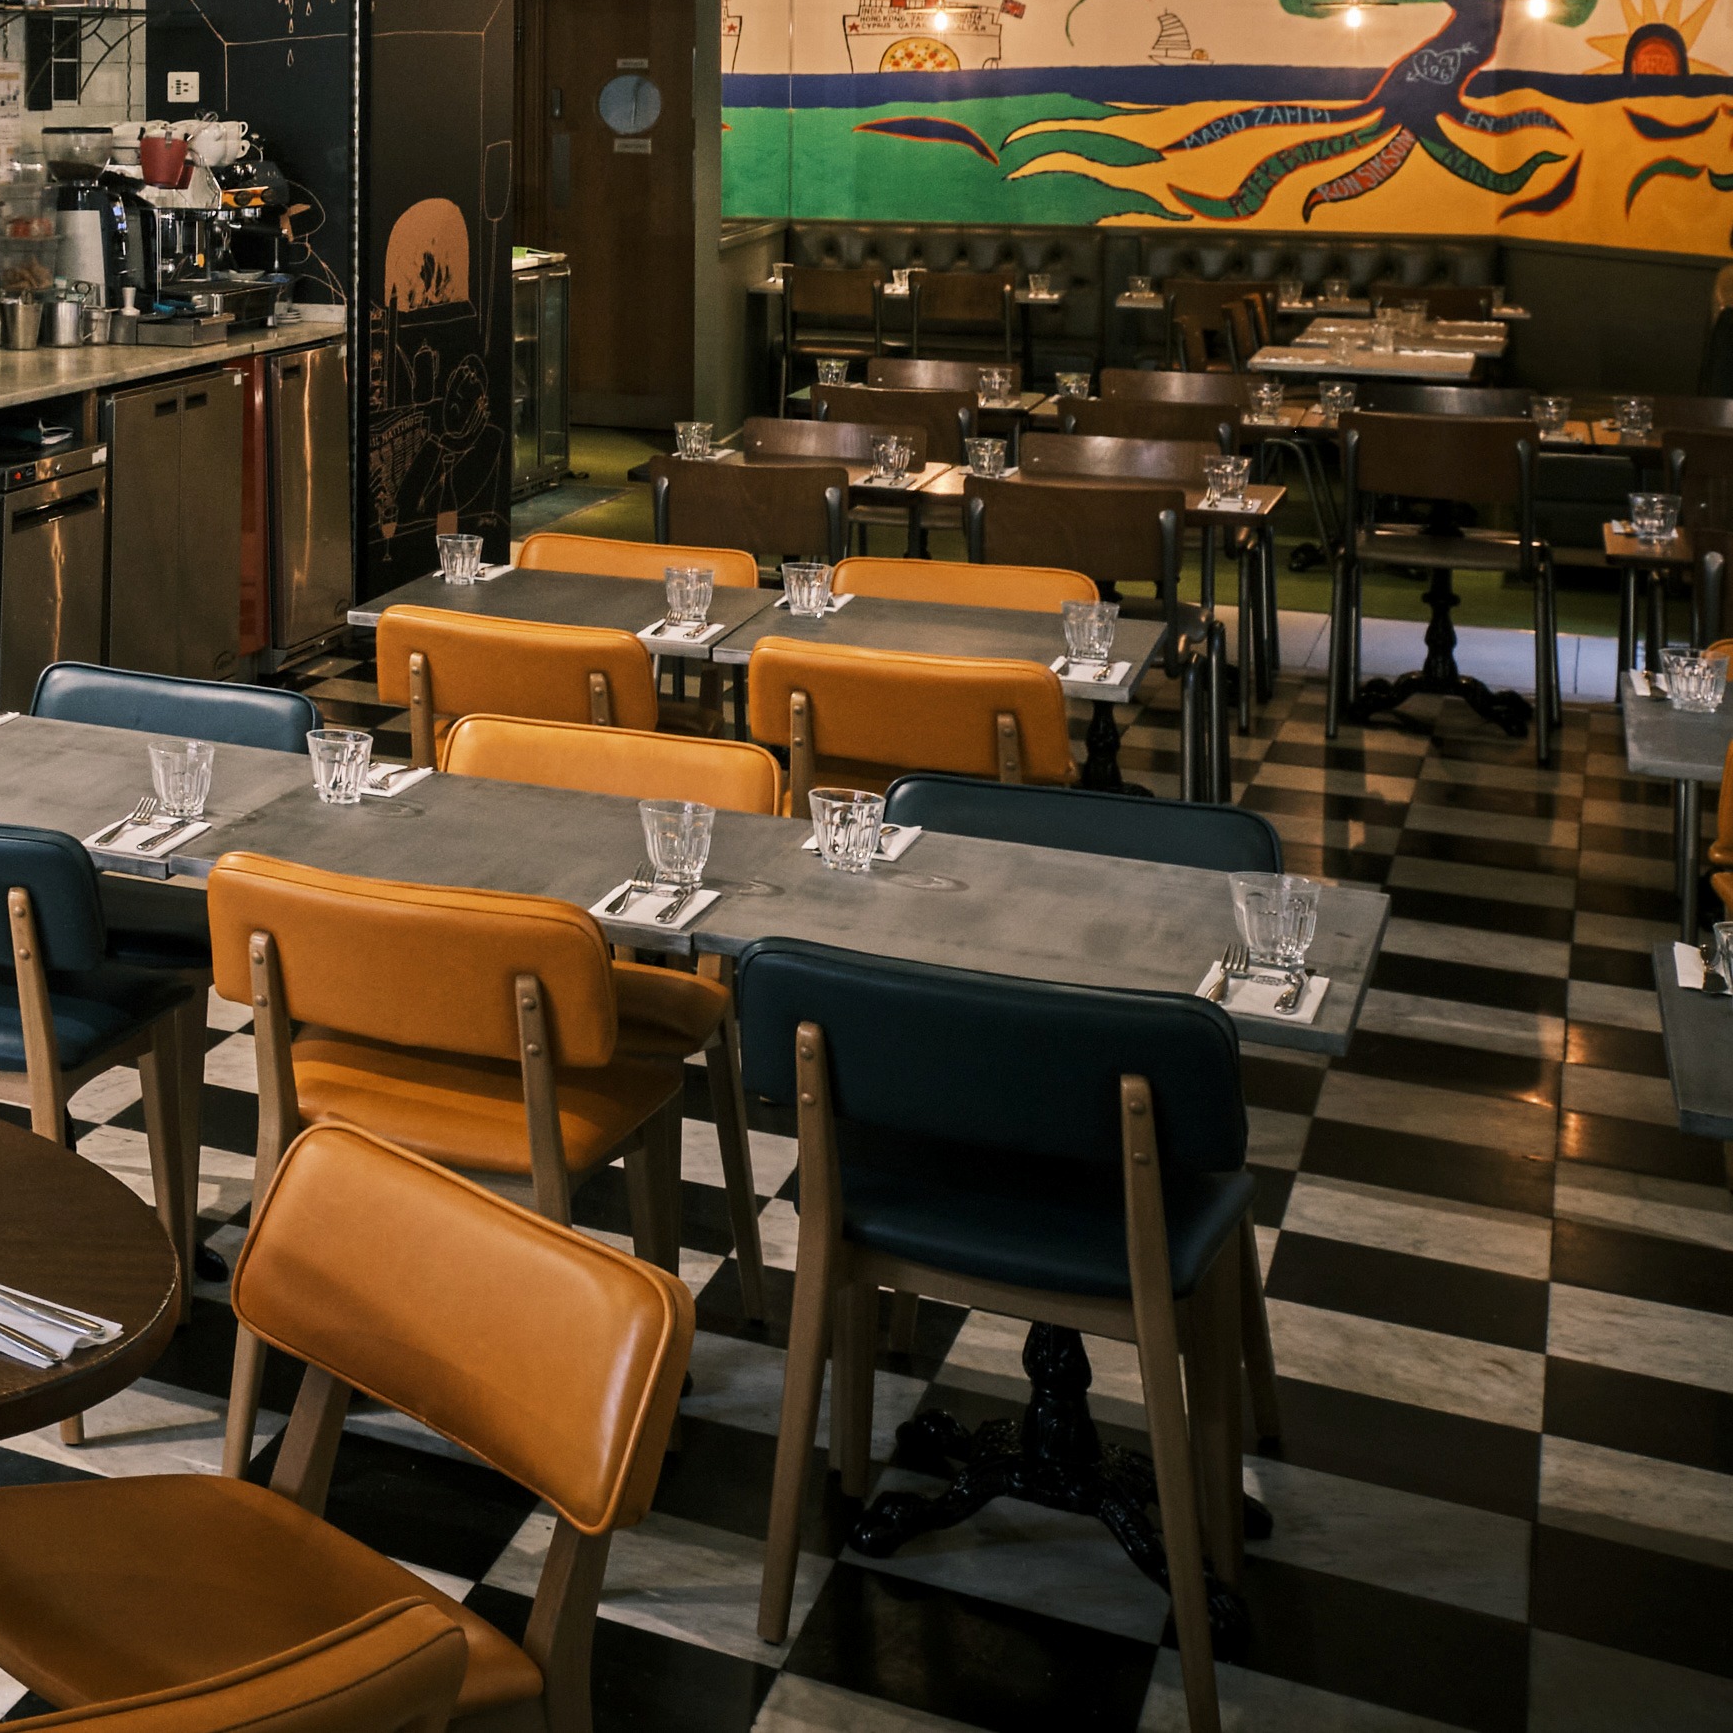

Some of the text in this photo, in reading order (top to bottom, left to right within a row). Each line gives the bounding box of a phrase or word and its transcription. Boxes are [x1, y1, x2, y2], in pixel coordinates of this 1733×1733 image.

[1183, 106, 1332, 150] MARIO ZAMPI
[1316, 174, 1364, 202] RON
